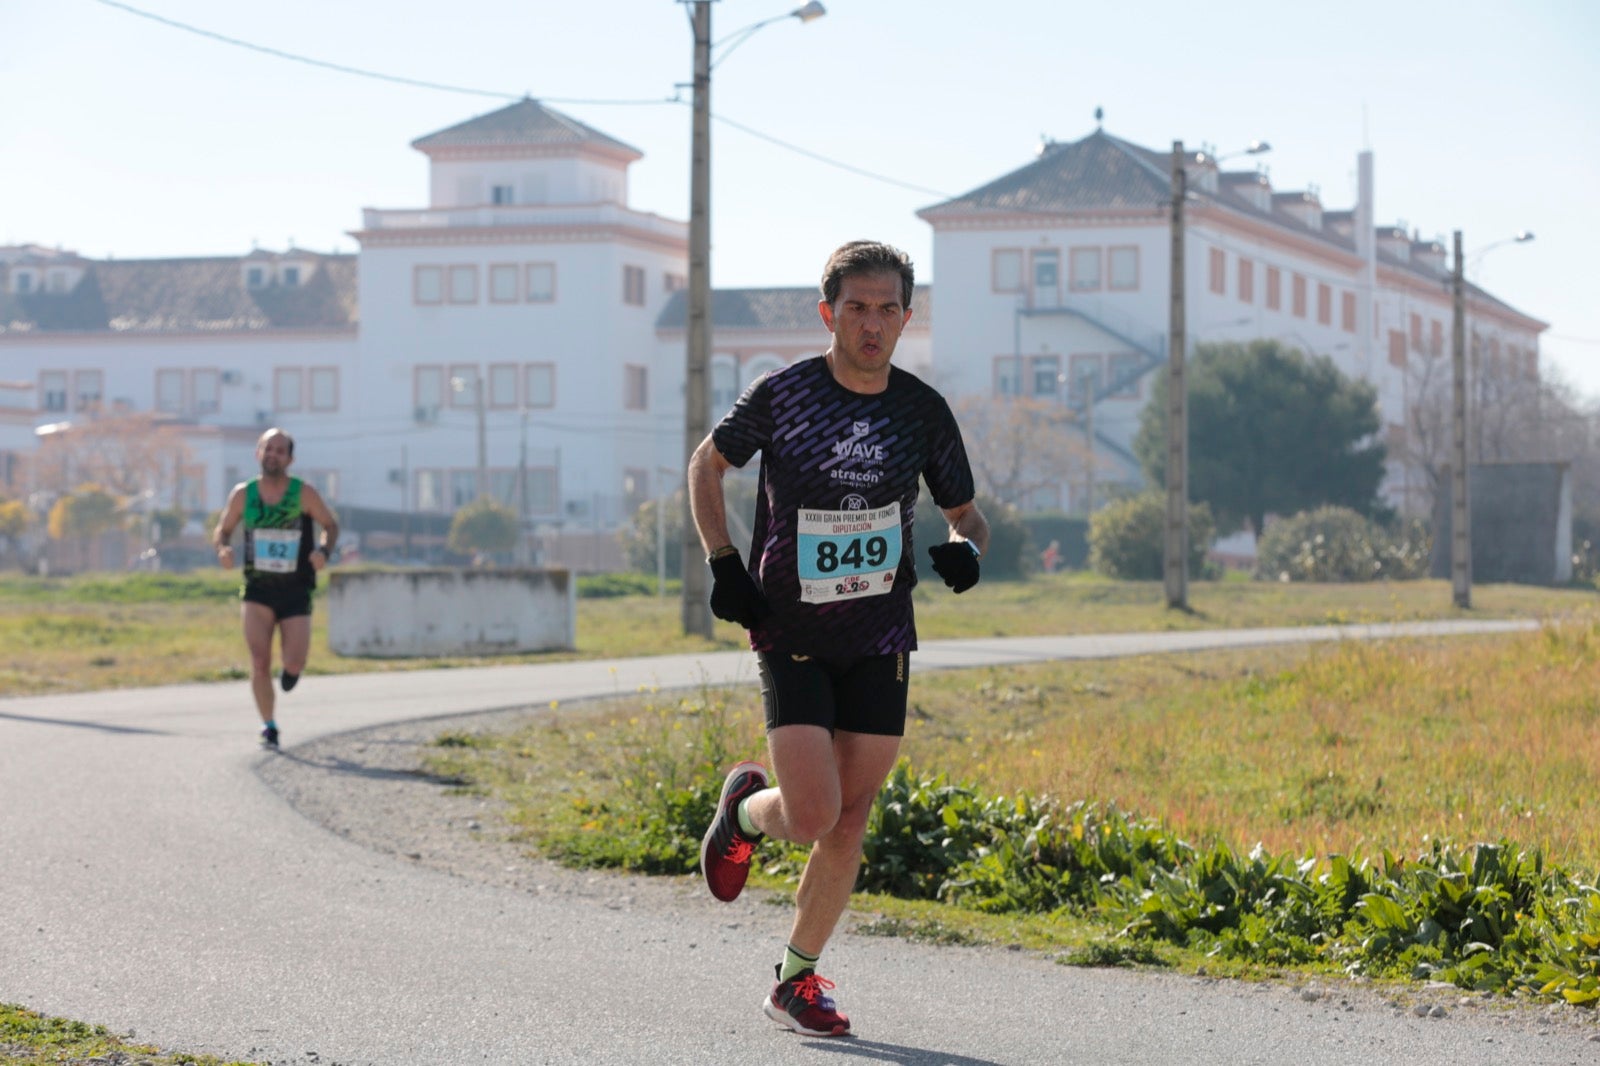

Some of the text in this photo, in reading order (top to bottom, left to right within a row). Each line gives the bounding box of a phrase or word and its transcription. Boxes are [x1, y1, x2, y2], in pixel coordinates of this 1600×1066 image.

[835, 441, 884, 461] WAVE
[823, 513, 841, 523] GRAN
[842, 512, 867, 523] PREMIO
[868, 511, 877, 521] DE
[267, 542, 288, 559] 62
[816, 535, 888, 573] 849
